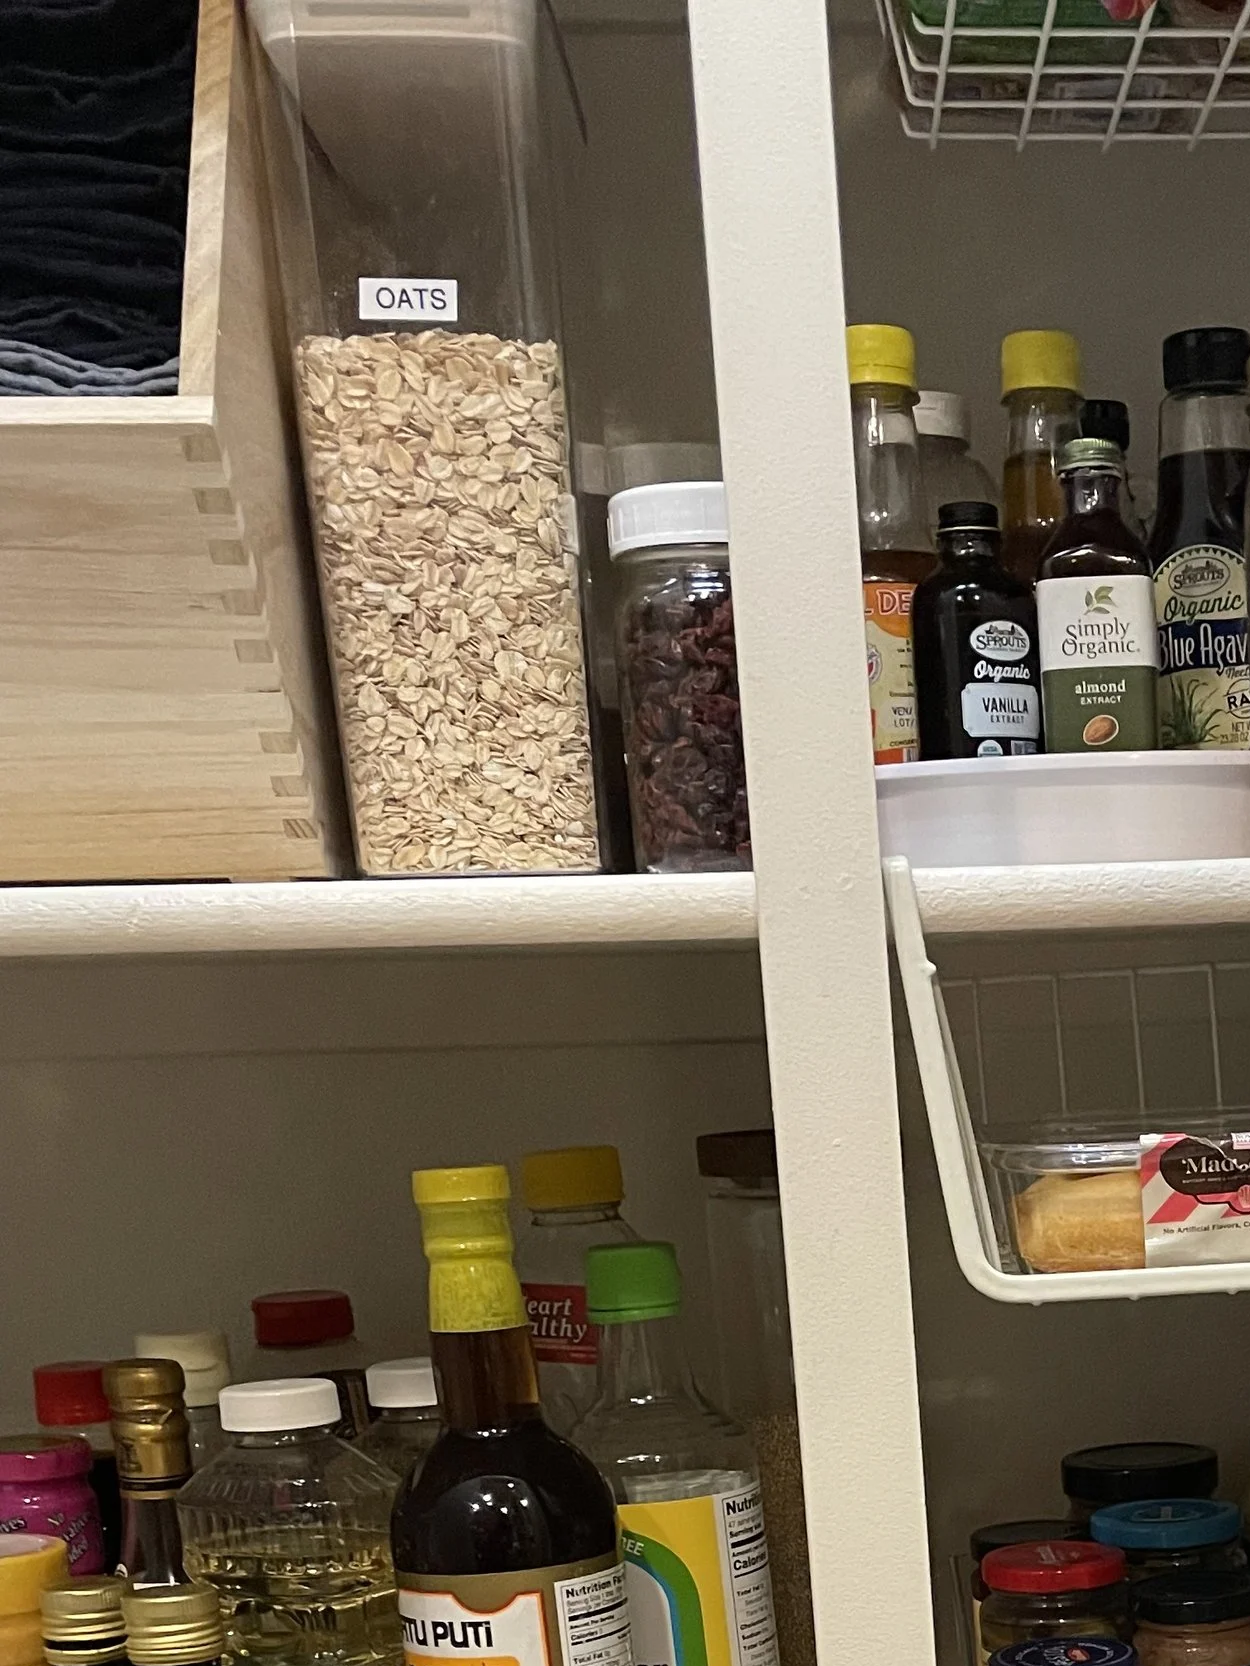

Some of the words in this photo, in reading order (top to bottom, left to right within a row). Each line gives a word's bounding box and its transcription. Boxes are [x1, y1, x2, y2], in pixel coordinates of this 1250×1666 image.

[375, 287, 447, 311] OATS
[1173, 568, 1225, 590] SPROUTS
[1163, 591, 1245, 625] Organic
[1065, 617, 1130, 640] Simply
[976, 634, 1027, 650] SPROUTS
[1061, 637, 1136, 660] Organic
[1158, 626, 1195, 672] Blue
[1199, 622, 1249, 677] Agav
[974, 660, 1031, 682] Organic
[1074, 679, 1126, 695] almond
[982, 697, 1029, 714] VANILLA
[1080, 695, 1122, 705] EXTRACT
[1227, 693, 1250, 710] RA
[990, 714, 1025, 724] EXTRACT
[1163, 1227, 1175, 1235] No
[1177, 1225, 1211, 1234] Artificial
[1212, 1222, 1242, 1232] Flavors,
[566, 1579, 612, 1599] Nutrition
[573, 1655, 592, 1665] Total
